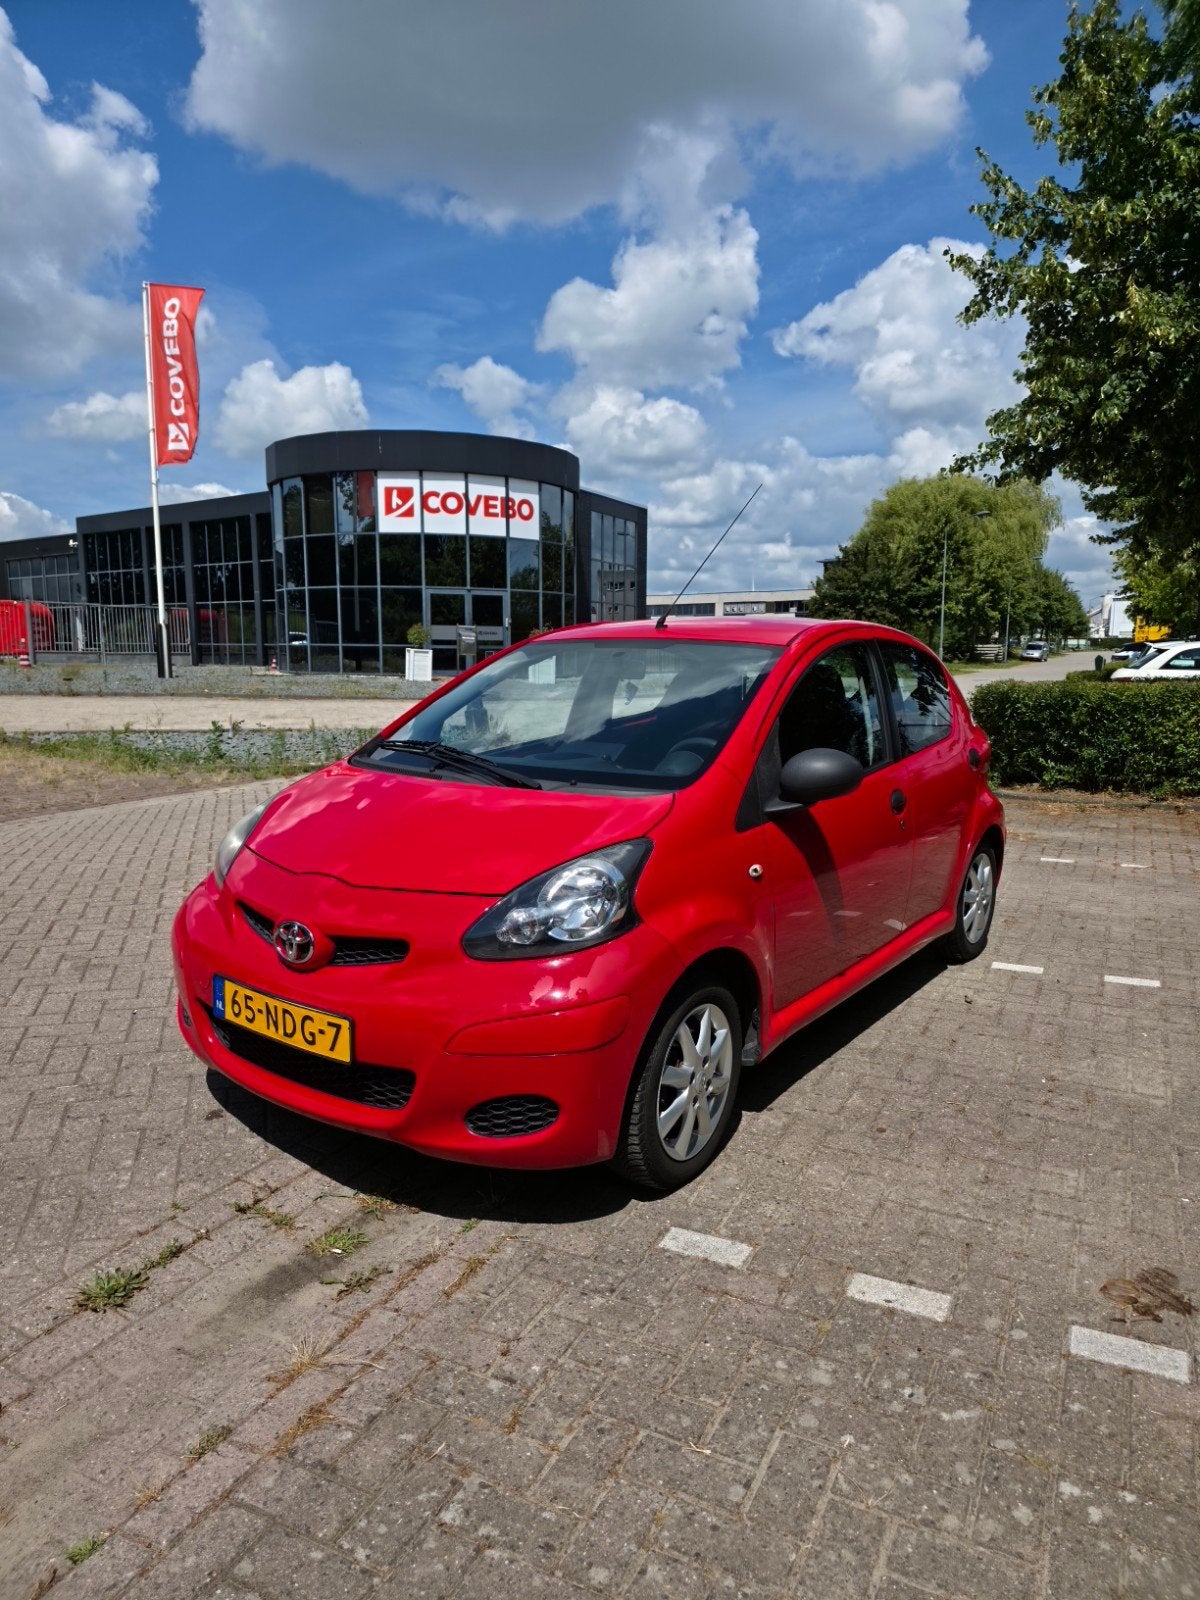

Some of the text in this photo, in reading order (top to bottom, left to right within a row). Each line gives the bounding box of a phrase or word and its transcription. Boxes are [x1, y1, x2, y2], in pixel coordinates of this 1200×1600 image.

[163, 297, 185, 417] COVEBO
[422, 491, 534, 522] COVEBO
[231, 990, 342, 1052] 65-NDG-7
